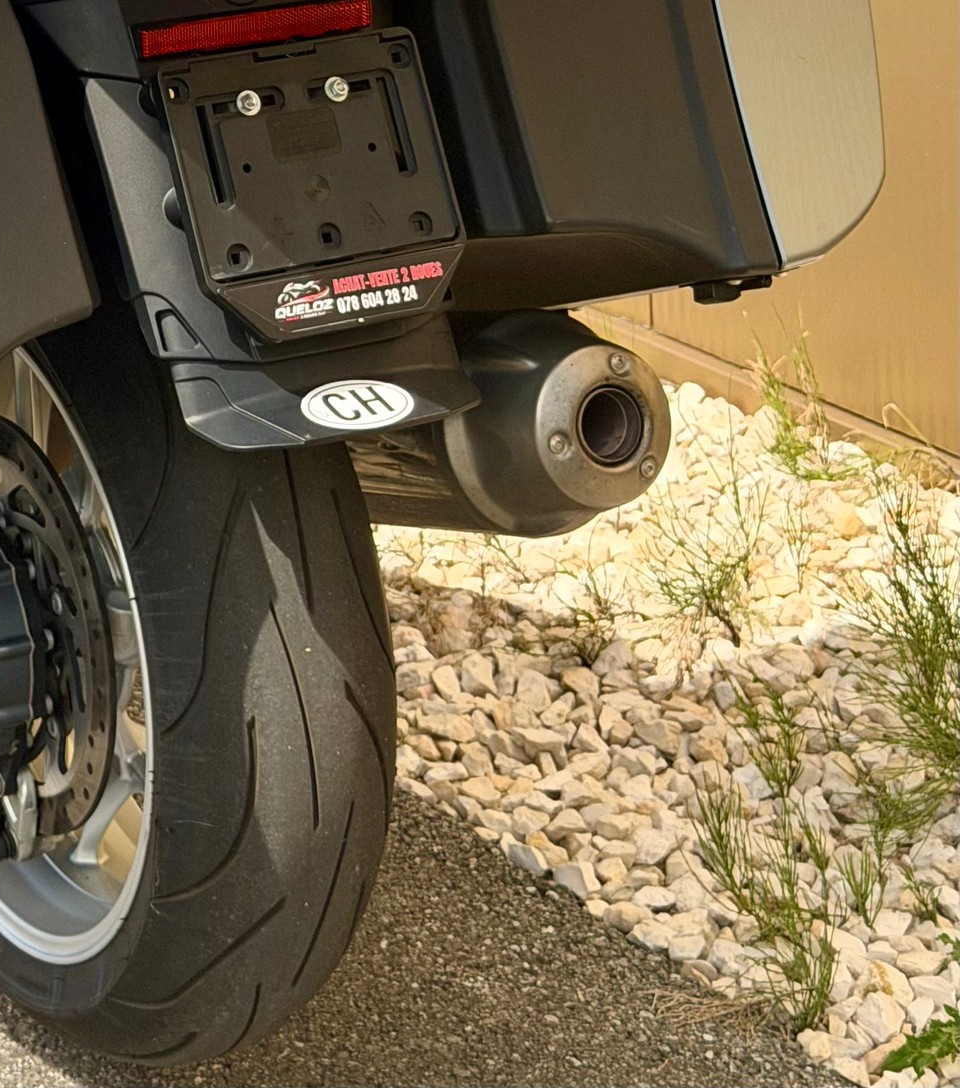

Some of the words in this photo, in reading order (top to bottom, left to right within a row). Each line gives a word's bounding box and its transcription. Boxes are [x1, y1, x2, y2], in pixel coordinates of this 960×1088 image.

[400, 266, 411, 283] 2
[275, 298, 334, 320] QUELOZ
[336, 295, 360, 314] 078
[360, 290, 385, 310] 604
[401, 284, 419, 302] 24
[321, 386, 396, 421] CH
